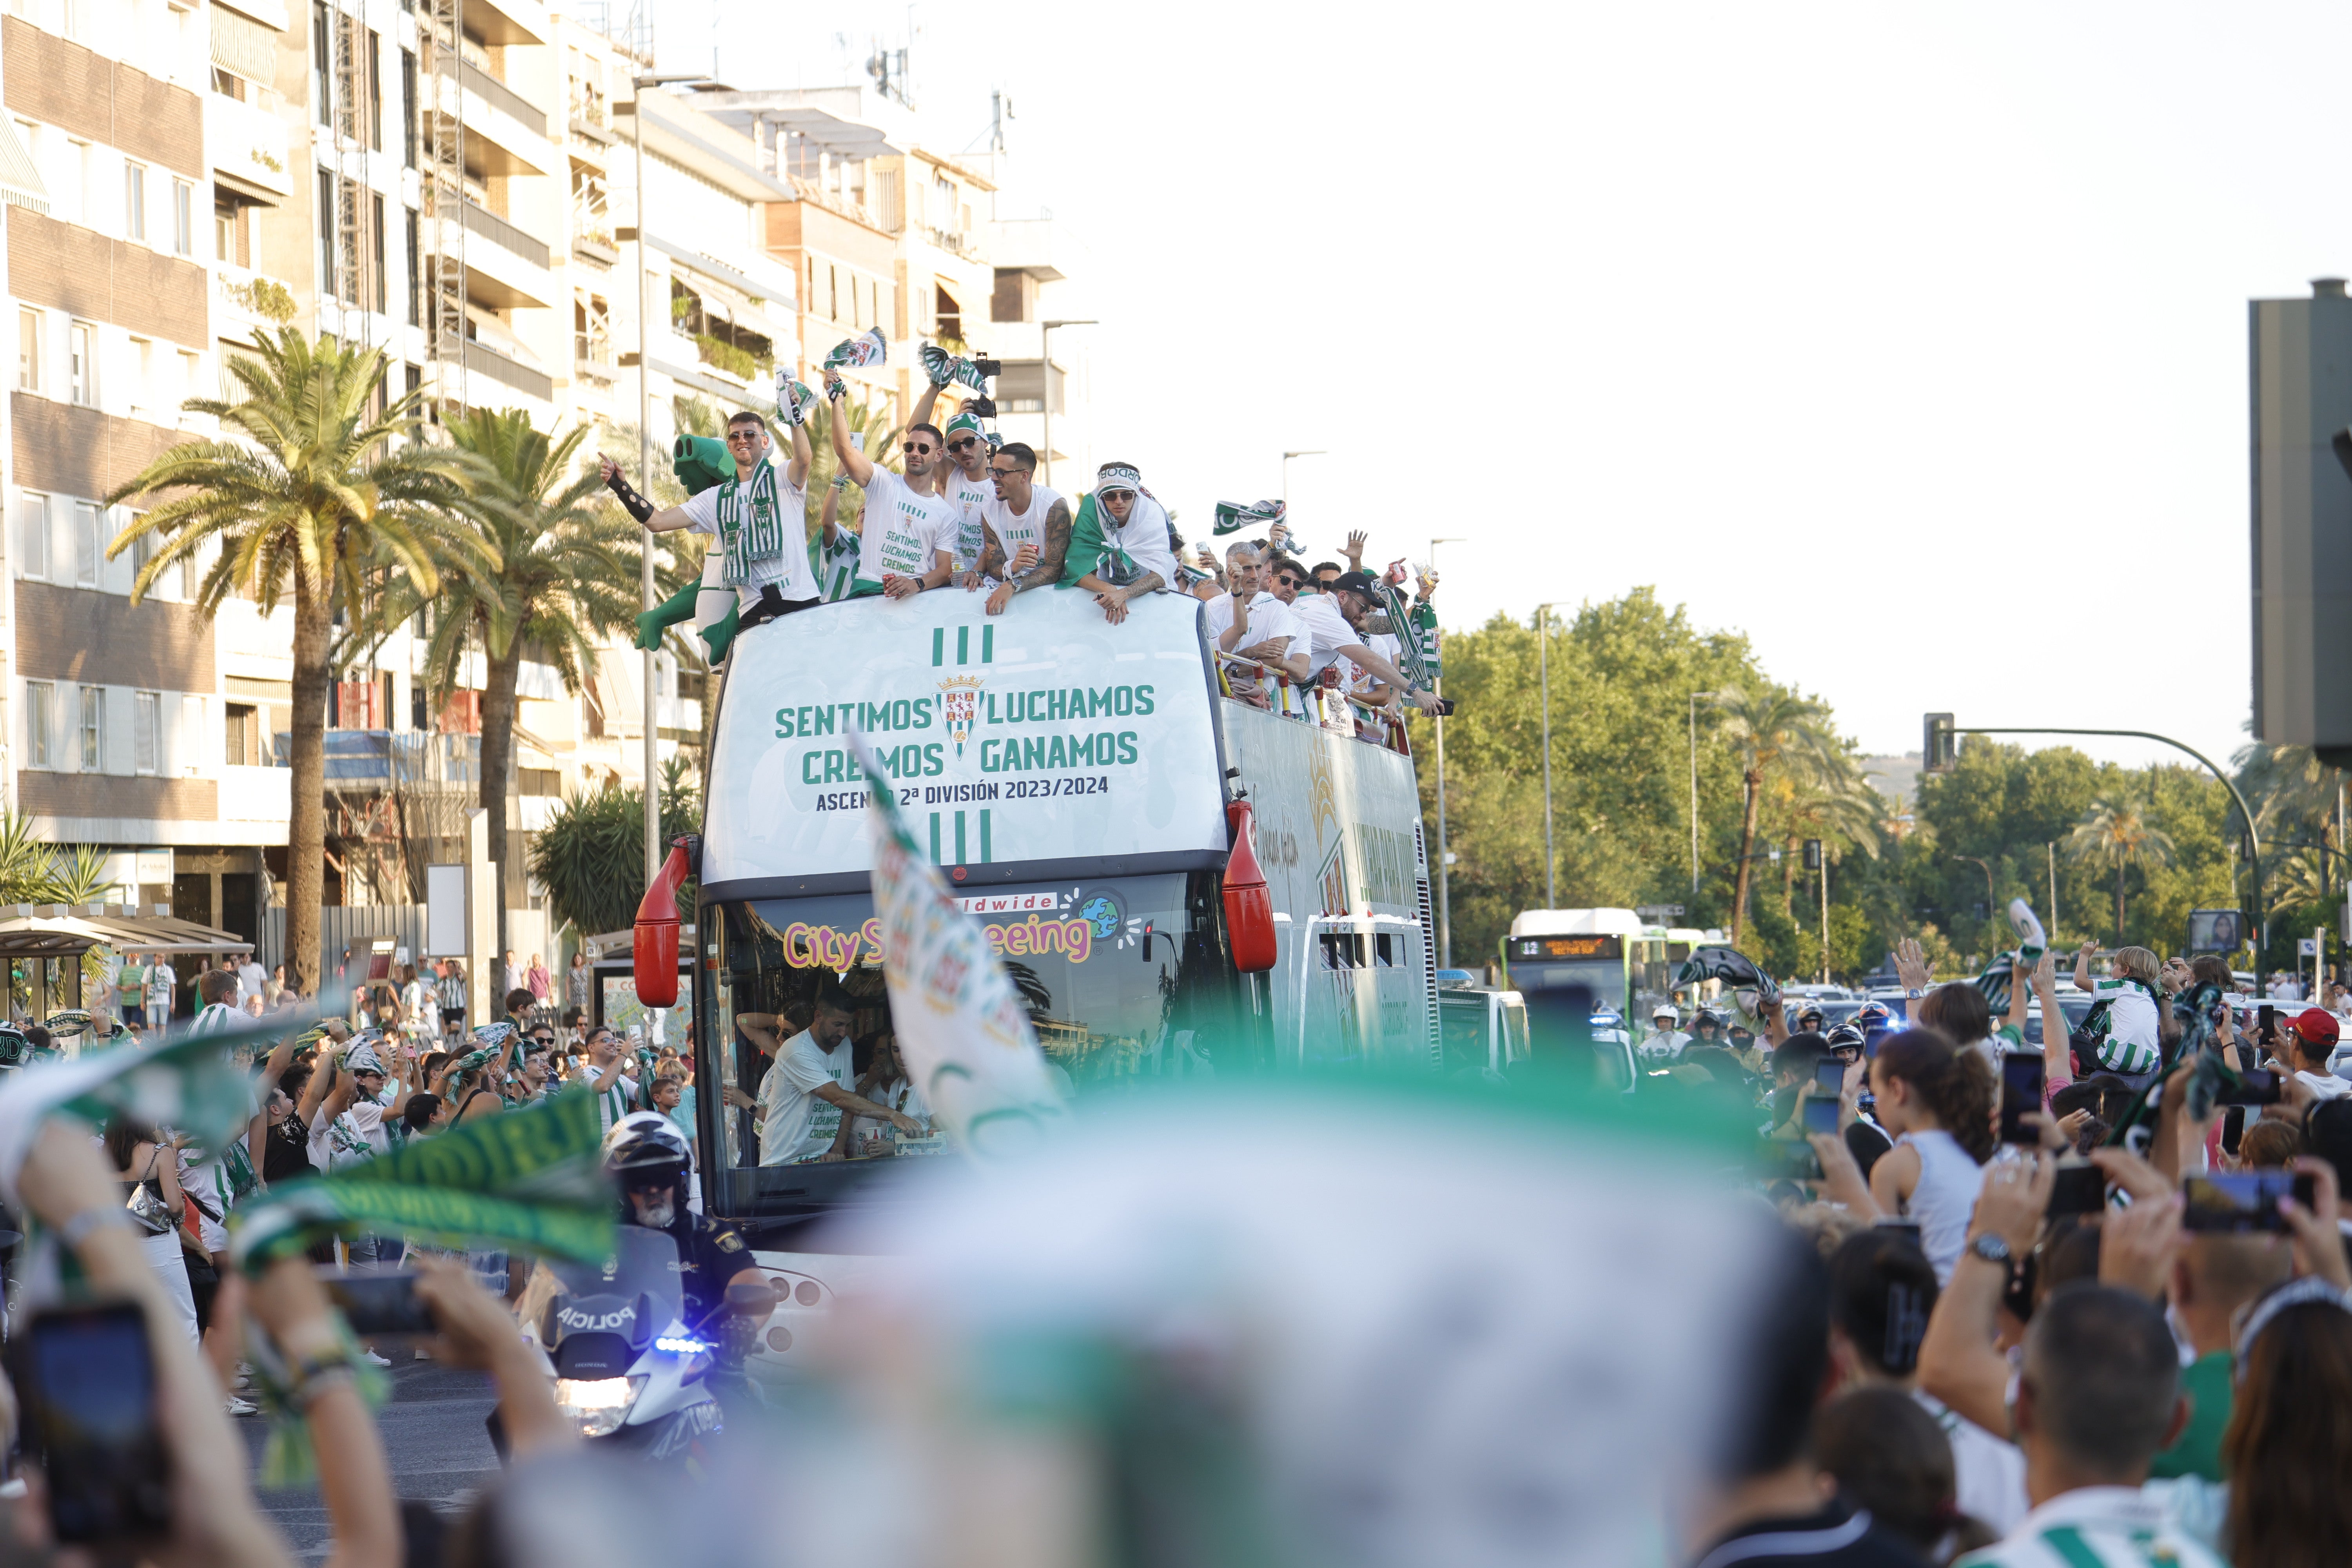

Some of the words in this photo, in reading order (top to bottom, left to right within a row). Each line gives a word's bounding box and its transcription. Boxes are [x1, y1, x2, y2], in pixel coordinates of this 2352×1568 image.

[880, 543, 922, 562] LUCHAMOS
[882, 557, 915, 574] CREIMOS
[775, 698, 932, 739] SENTIMOS
[987, 685, 1154, 724] LUCHAMOS
[980, 731, 1138, 773] GANAMOS
[926, 780, 998, 804] DIVISIÓN
[1005, 776, 1108, 799] 2023/2024
[1352, 822, 1385, 904] LUCHAR
[953, 895, 1052, 912] ldwide
[783, 922, 861, 974] City
